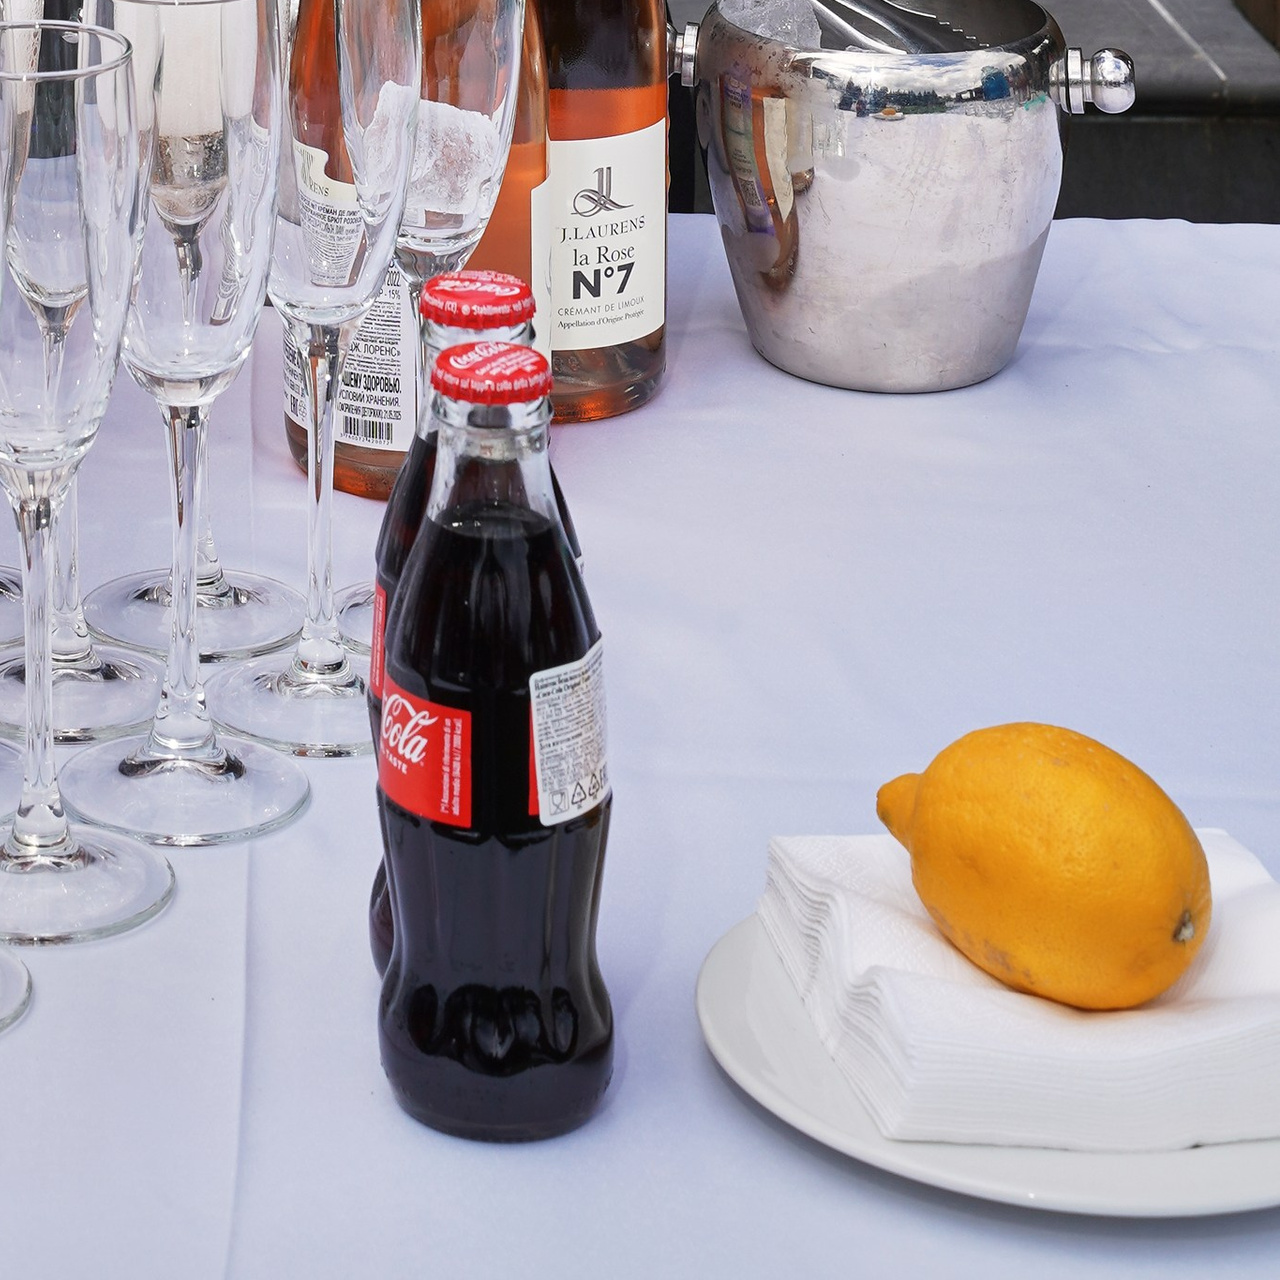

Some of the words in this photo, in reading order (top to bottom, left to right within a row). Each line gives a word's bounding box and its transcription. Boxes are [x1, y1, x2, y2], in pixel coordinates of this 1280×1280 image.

[560, 215, 646, 244] J.LAURENS
[572, 248, 590, 267] la
[557, 303, 602, 317] CRÉMANT
[604, 302, 616, 313] DE
[618, 296, 646, 310] LIMOUX
[557, 318, 596, 330] Appellation
